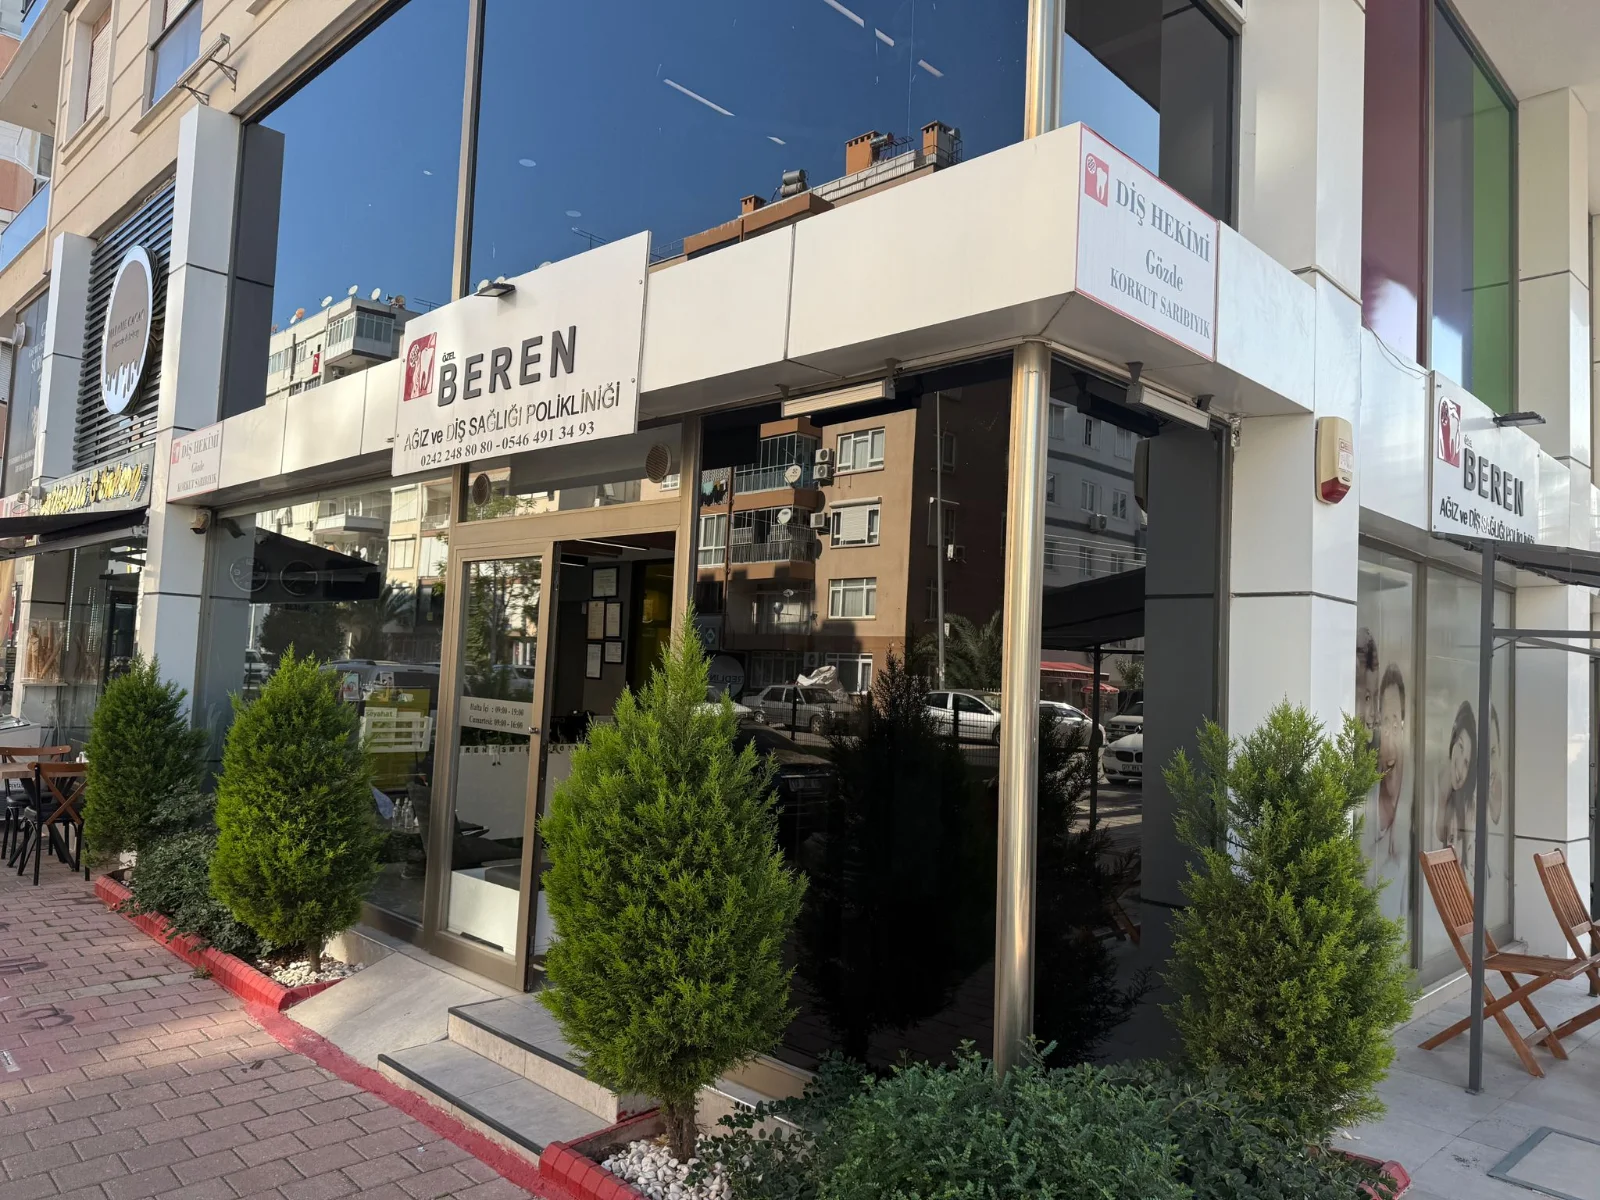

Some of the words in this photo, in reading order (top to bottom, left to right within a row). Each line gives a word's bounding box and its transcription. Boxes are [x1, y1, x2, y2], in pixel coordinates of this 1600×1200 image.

[1115, 178, 1146, 227] DİŞ
[1150, 201, 1211, 263] HEKİMİ
[1110, 267, 1158, 310] KORKUT
[1159, 296, 1211, 340] SARIBIYIK
[1145, 249, 1183, 292] Gözde
[437, 325, 577, 407] BEREN
[442, 351, 456, 363] ÖZEL
[404, 428, 430, 452] AĞIZ
[431, 429, 443, 444] ve
[446, 418, 466, 444] DİŞ
[468, 403, 522, 435] SAĞLIĞI
[526, 381, 620, 424] POLİKLİNİĞİ
[420, 451, 442, 467] 0242
[444, 446, 462, 462] 248
[465, 443, 478, 456] 80
[480, 440, 493, 454] 80
[501, 433, 529, 450] 0546
[532, 428, 554, 444] 491
[558, 425, 575, 440] 34
[578, 421, 595, 437] 93
[1463, 447, 1524, 517] BEREN
[1440, 496, 1459, 521] AĞIZ
[1460, 510, 1468, 525] ve
[1469, 508, 1480, 534] DİŞ
[1481, 516, 1505, 540] SAĞLIĞI
